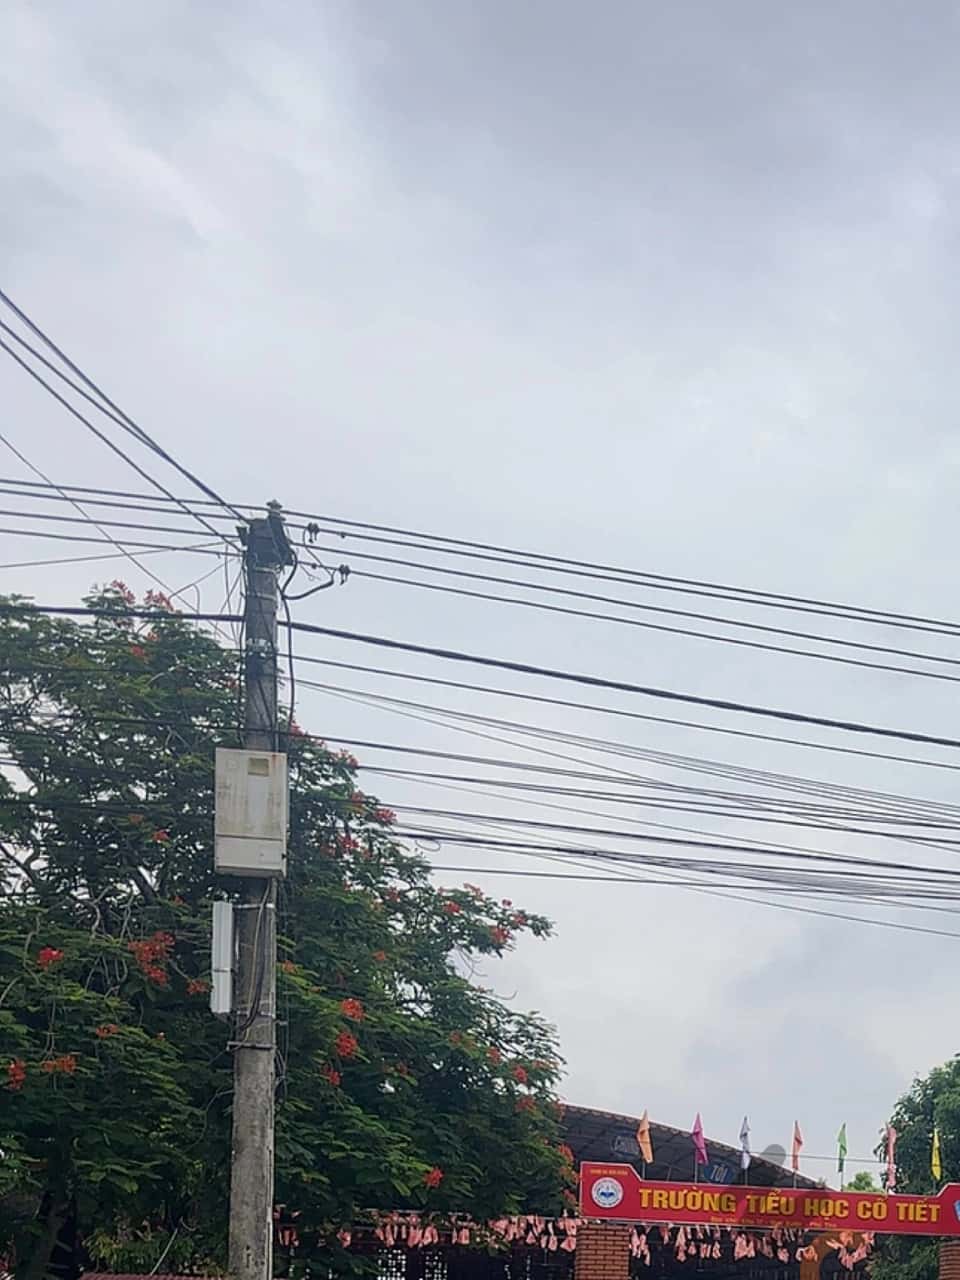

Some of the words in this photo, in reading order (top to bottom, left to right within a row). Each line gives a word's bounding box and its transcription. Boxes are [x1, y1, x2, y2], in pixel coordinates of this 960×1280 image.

[639, 1186, 736, 1213] TRƯỜNG
[746, 1188, 795, 1216] TIỂU
[804, 1198, 849, 1220] HỌC
[896, 1197, 941, 1223] TIẾT
